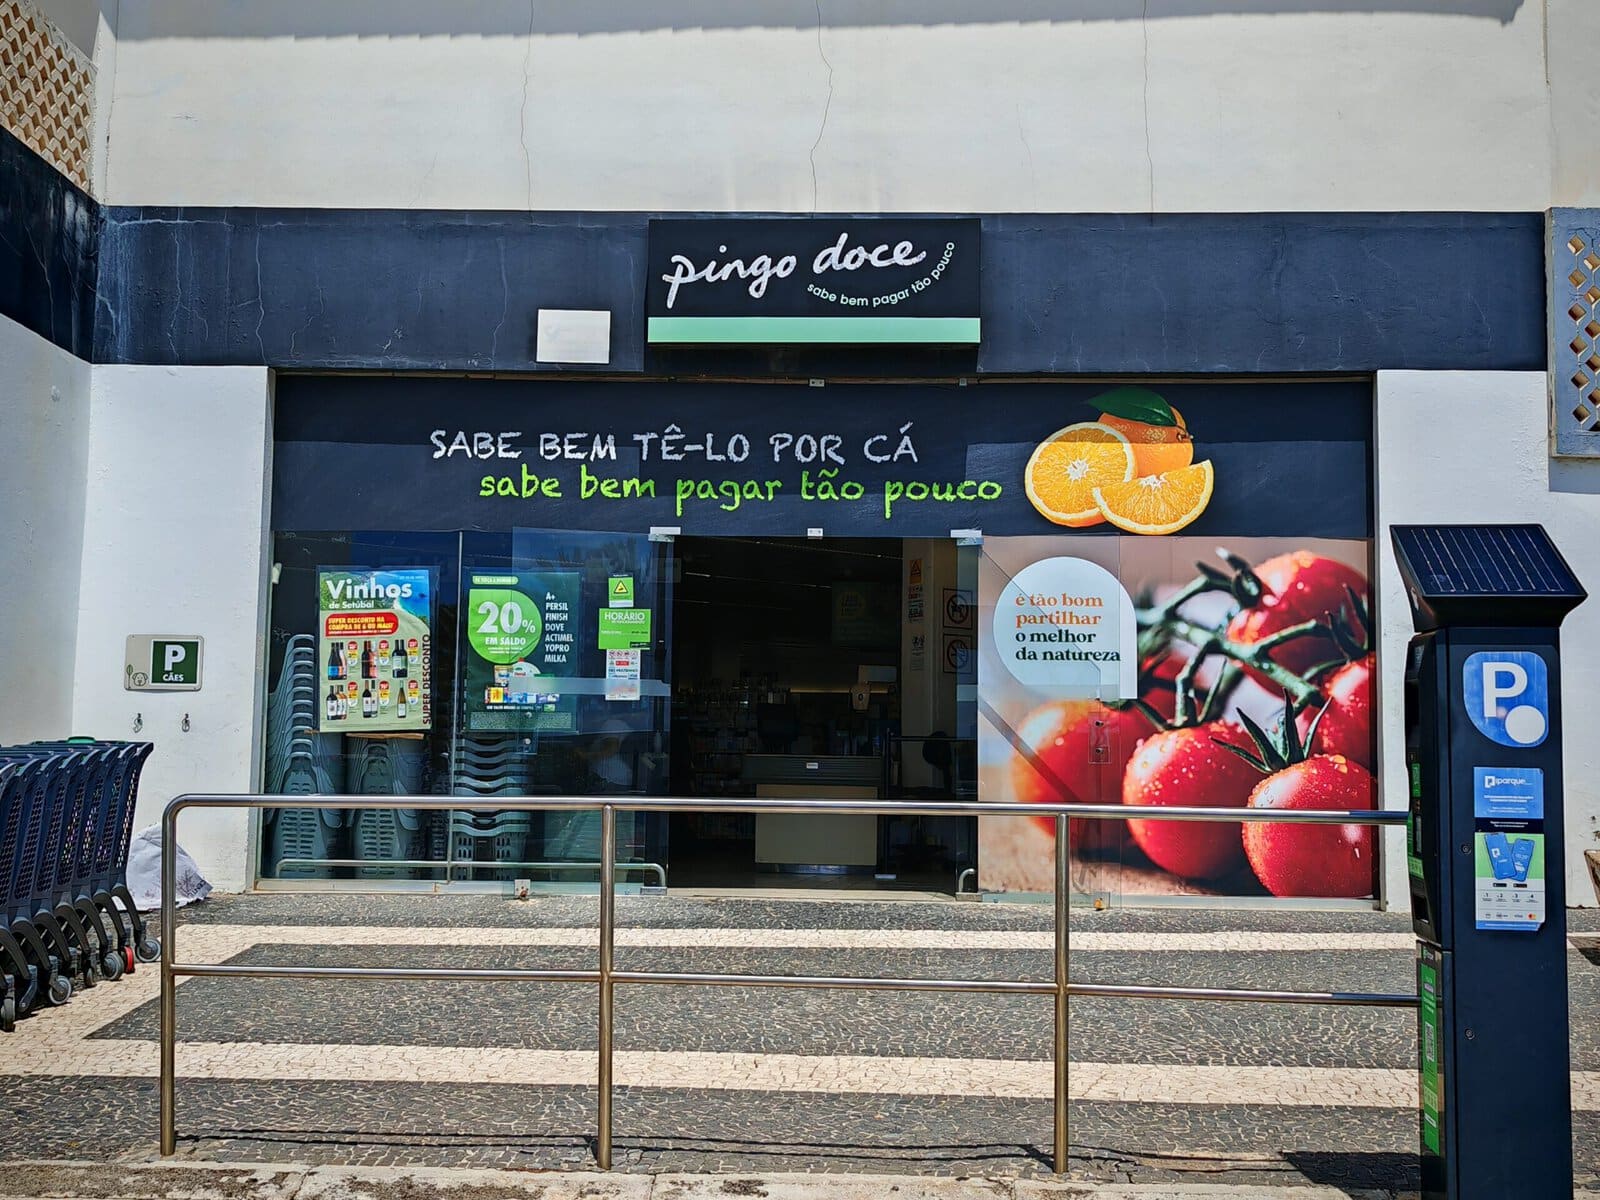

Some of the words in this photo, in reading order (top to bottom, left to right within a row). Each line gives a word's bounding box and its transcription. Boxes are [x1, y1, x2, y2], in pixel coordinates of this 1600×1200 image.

[662, 245, 797, 309] pingo
[812, 232, 927, 274] doce
[807, 283, 837, 302] sabe
[840, 294, 869, 306] bem
[872, 288, 910, 308] pagar
[911, 277, 932, 293] tão
[931, 242, 955, 280] pouco
[430, 429, 522, 460] SABE
[538, 429, 617, 461] BEM
[633, 424, 750, 463] TÊ-LO
[769, 431, 846, 465] POR
[864, 422, 919, 464] CÁ
[479, 464, 562, 499] sabe
[580, 464, 656, 499] bem
[676, 476, 783, 516] pagar
[801, 468, 863, 500] tão
[884, 478, 1003, 518] pouco
[326, 576, 413, 599] Vinhos
[328, 600, 340, 609] de
[342, 600, 375, 609] Setúbal
[545, 602, 569, 611] PERSIL
[1016, 593, 1026, 607] é
[1029, 593, 1058, 607] tão
[1062, 593, 1104, 607] bom
[476, 601, 536, 634] 20%
[545, 613, 568, 621] FINISH
[604, 610, 646, 621] HORÁRIO
[1016, 611, 1102, 629] partilhar
[545, 623, 565, 632] DOVE
[485, 637, 498, 645] EM
[500, 637, 526, 646] SALDO
[545, 633, 574, 642] ACTIMEL
[1015, 631, 1026, 643] o
[1029, 629, 1097, 643] melhor
[545, 644, 570, 652] YOPRO
[1015, 647, 1040, 661] da
[1042, 648, 1121, 662] natureza
[164, 644, 186, 671] P
[422, 634, 431, 690] DESCONTO
[544, 654, 567, 663] MILKA
[162, 672, 184, 682] CÃES
[1482, 662, 1528, 718] P
[422, 693, 431, 725] SUPER
